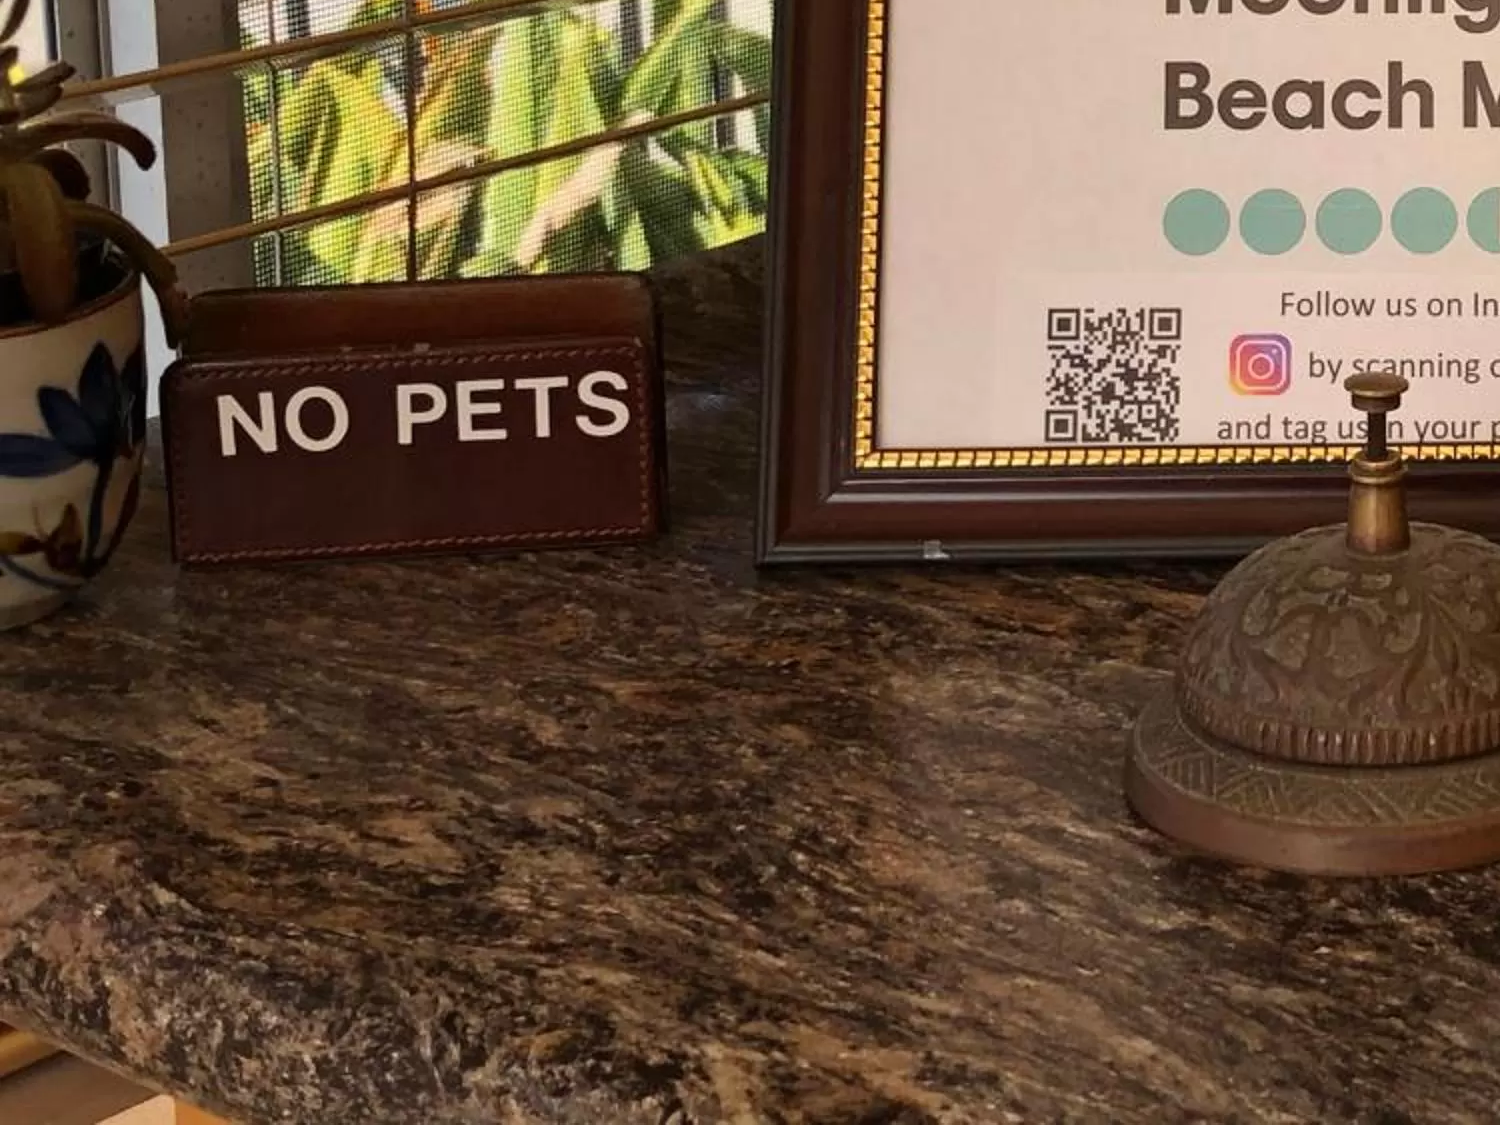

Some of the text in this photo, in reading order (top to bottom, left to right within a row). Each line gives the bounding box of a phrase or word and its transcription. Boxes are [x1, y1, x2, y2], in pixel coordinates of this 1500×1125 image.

[1164, 61, 1434, 130] Beach
[1282, 291, 1375, 317] Follow
[1387, 298, 1416, 317] us
[1427, 299, 1462, 317] on
[1310, 352, 1343, 384] by
[1352, 352, 1481, 384] scanning
[218, 371, 629, 456] NO PETS
[1217, 414, 1270, 440] and
[1283, 415, 1327, 443] tag
[1338, 420, 1369, 440] us
[1414, 420, 1482, 443] your
